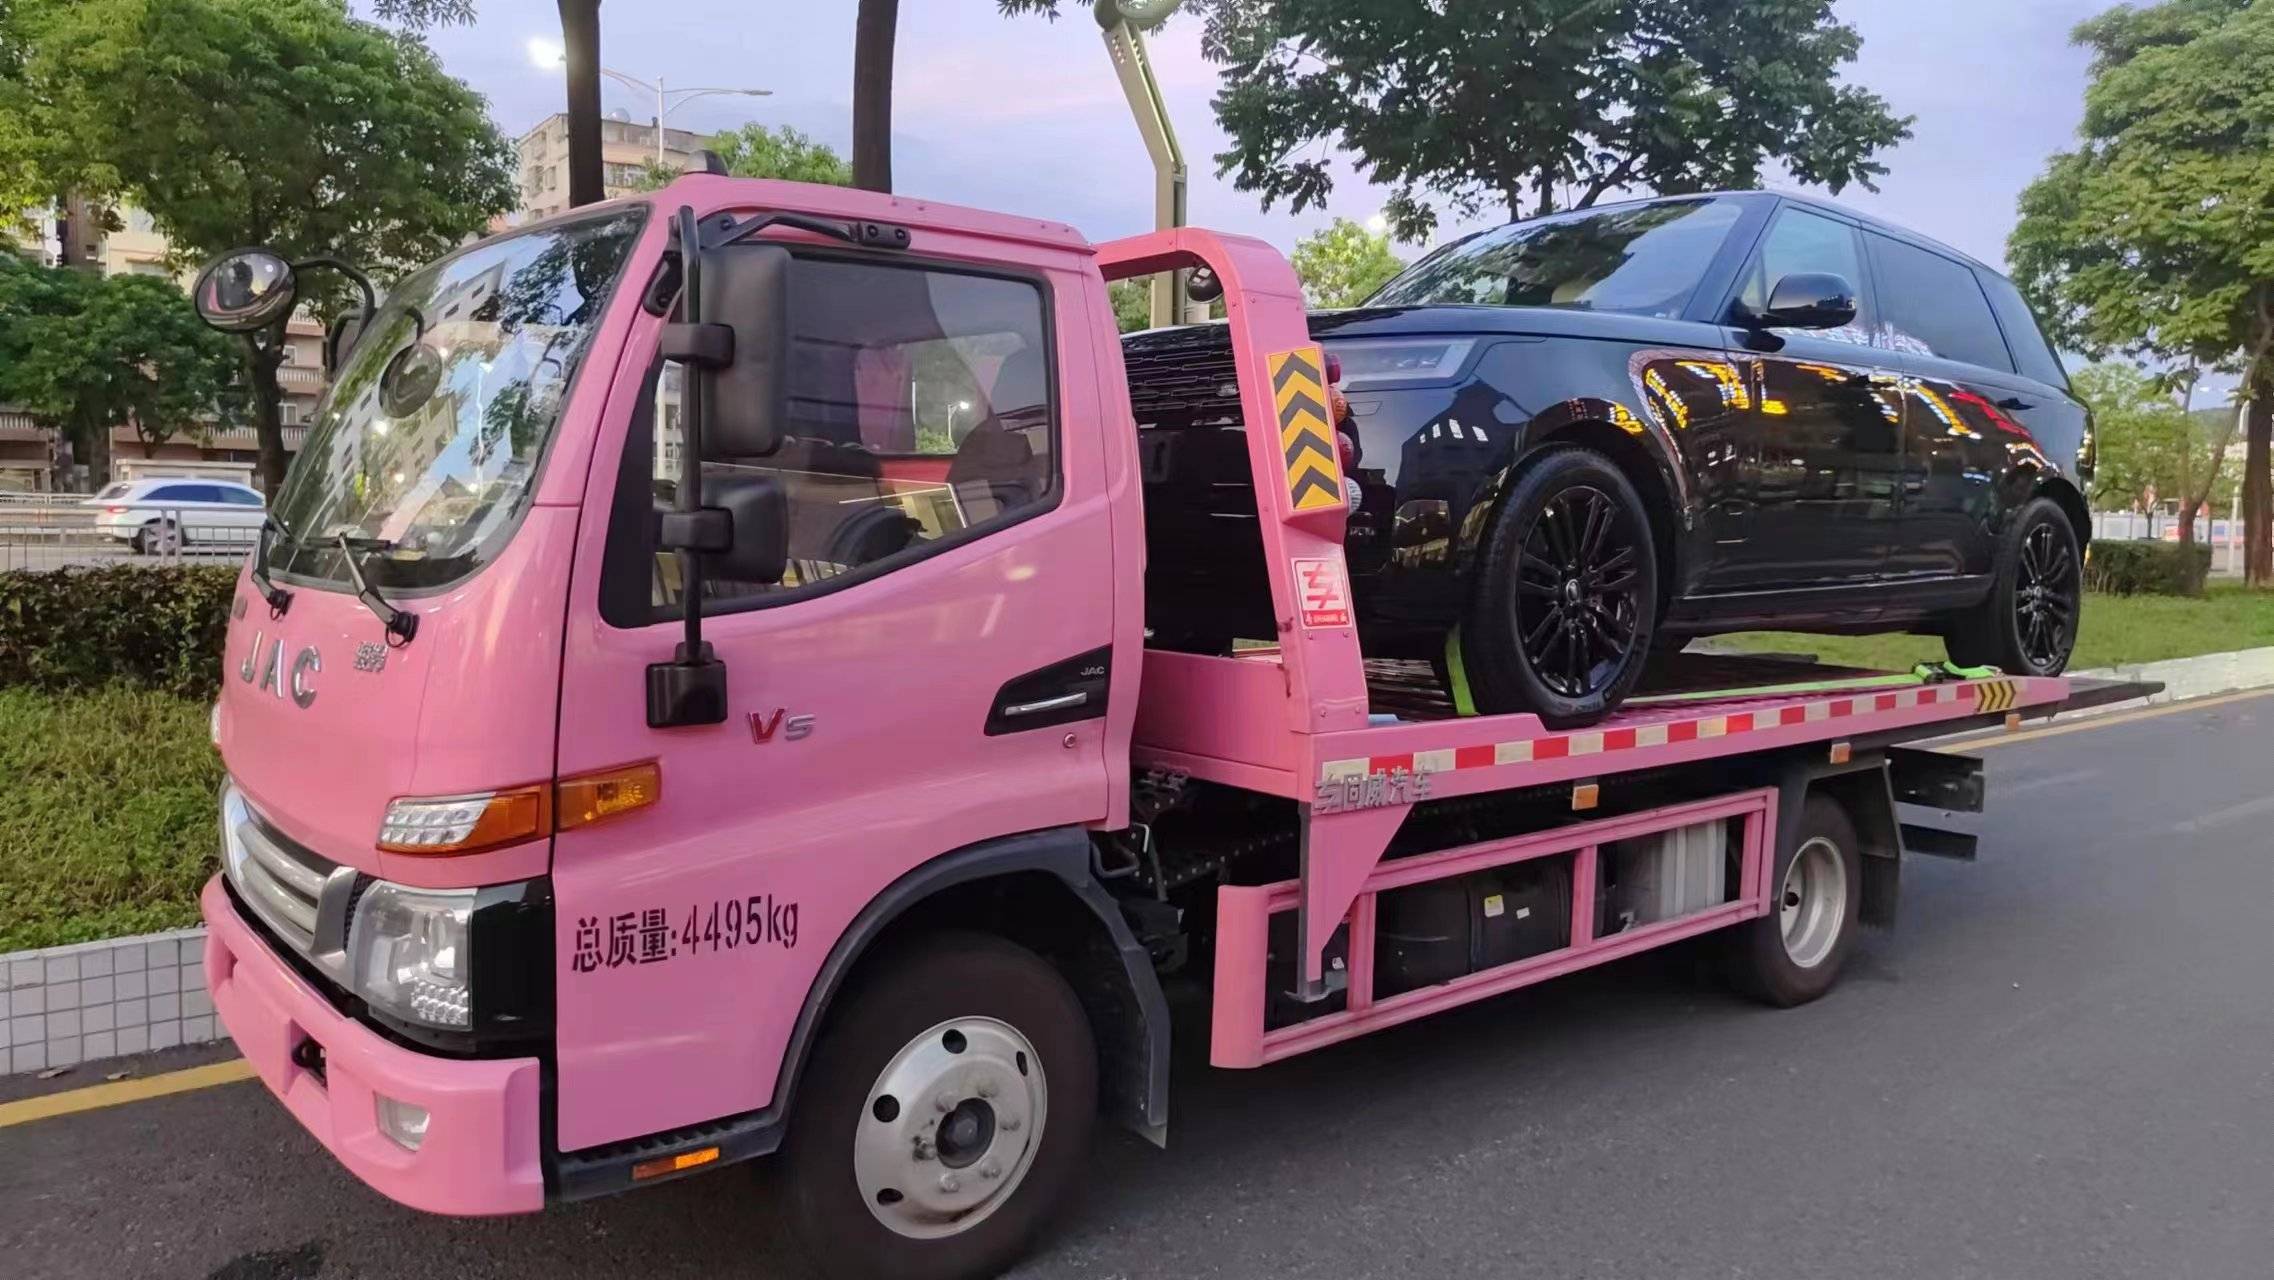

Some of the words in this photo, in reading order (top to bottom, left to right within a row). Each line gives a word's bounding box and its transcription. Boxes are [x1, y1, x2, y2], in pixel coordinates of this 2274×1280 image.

[241, 631, 321, 709] JAC
[1080, 666, 1105, 676] JAC
[572, 894, 798, 973] 总质量:4495kg
